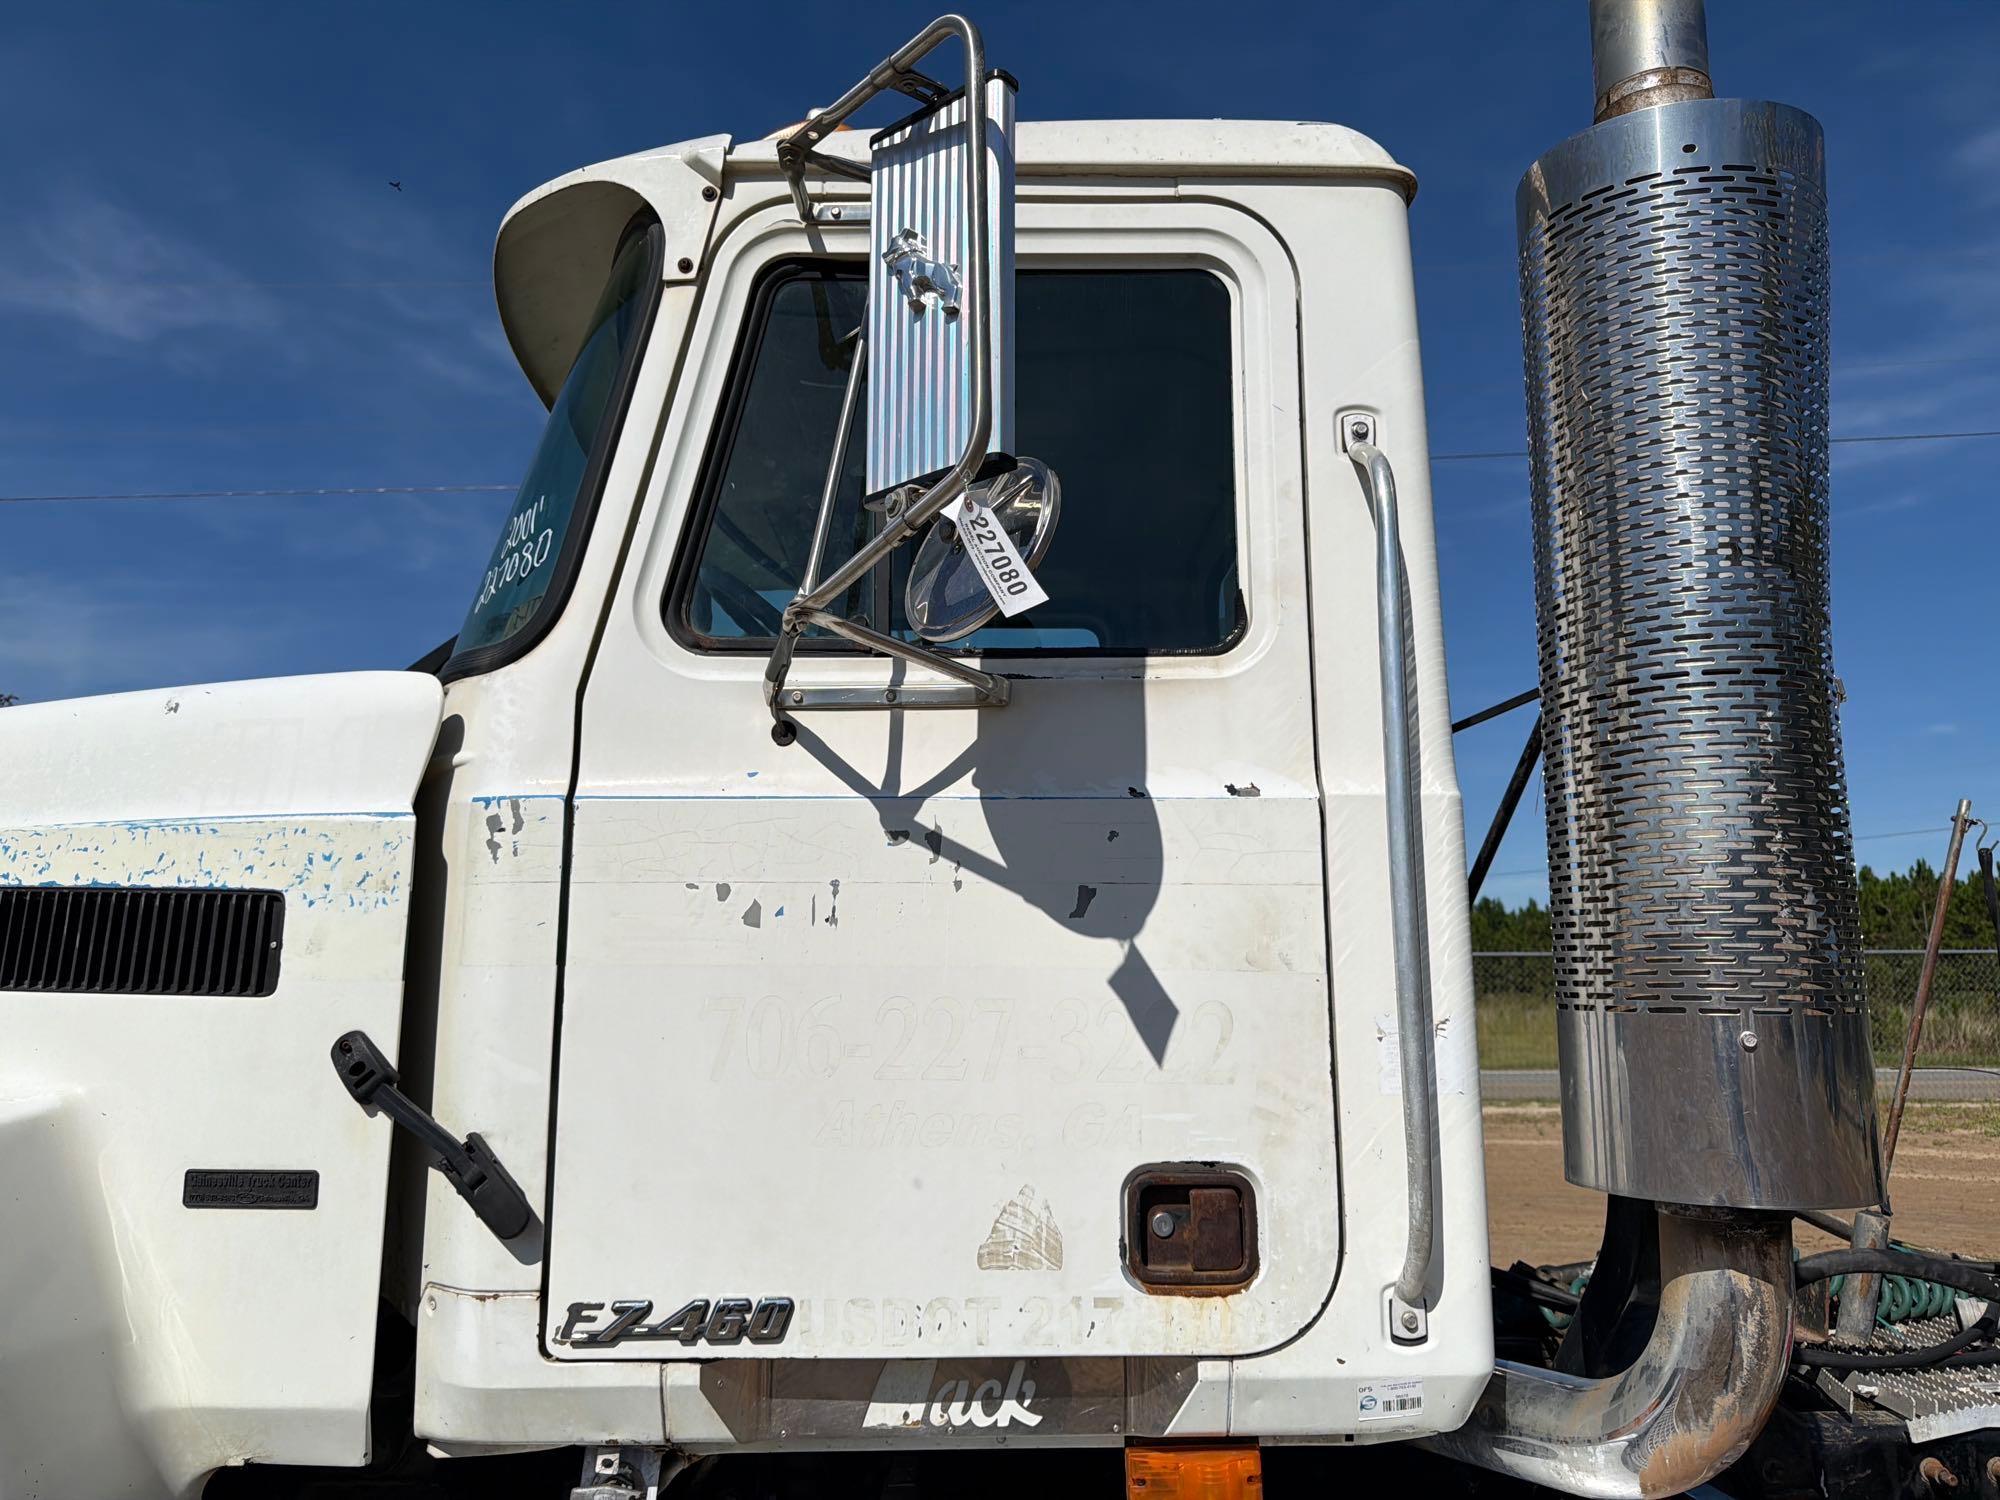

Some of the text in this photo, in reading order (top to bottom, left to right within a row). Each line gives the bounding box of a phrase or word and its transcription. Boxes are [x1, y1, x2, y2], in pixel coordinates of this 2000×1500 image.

[474, 528, 553, 614] 227080
[968, 516, 1028, 596] 227080
[973, 543, 989, 568] AUCTION
[988, 569, 1006, 597] COMPANY
[798, 1296, 1001, 1347] USDOT
